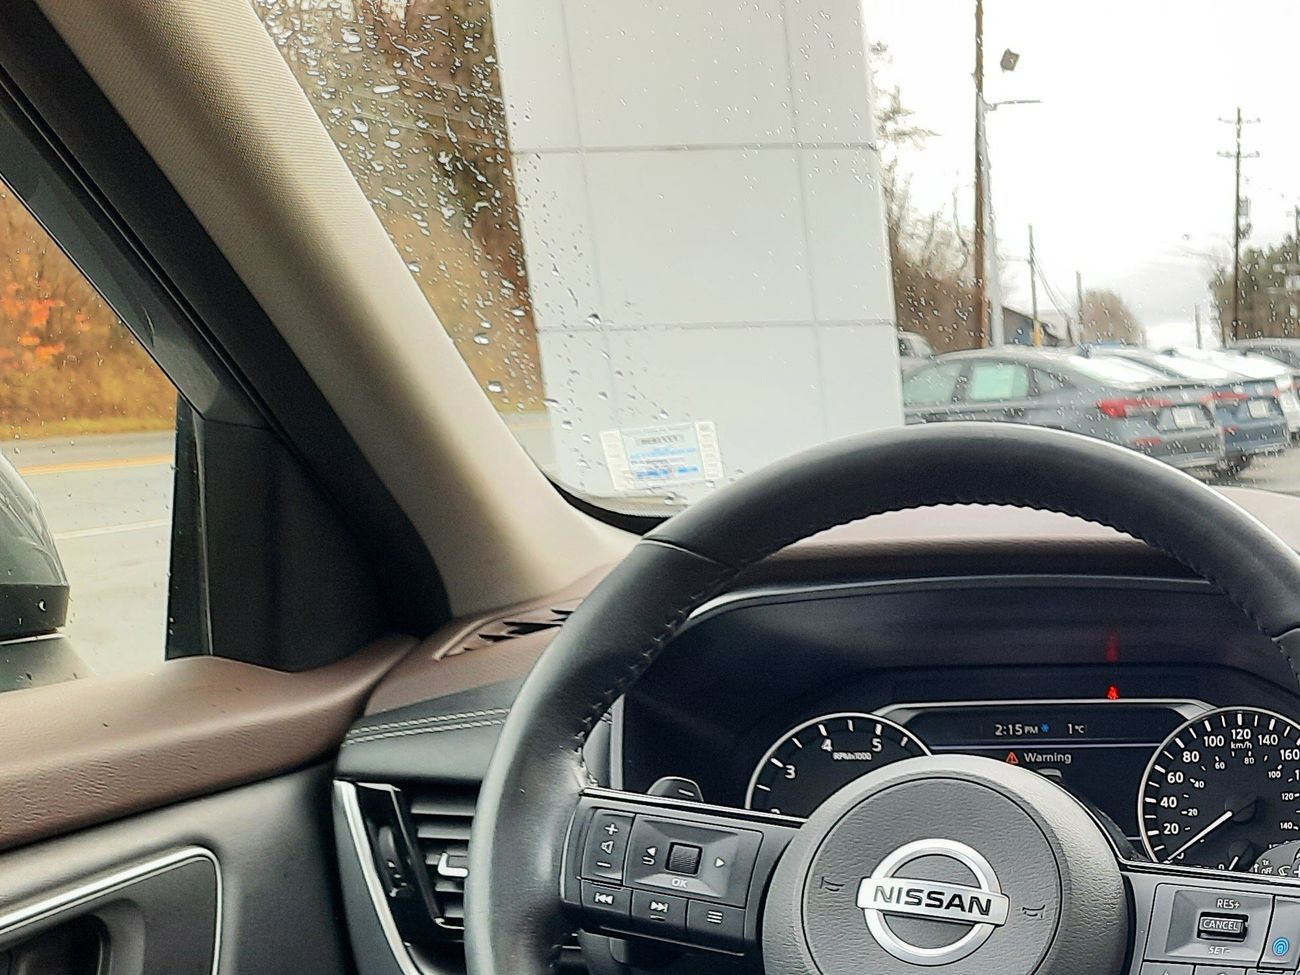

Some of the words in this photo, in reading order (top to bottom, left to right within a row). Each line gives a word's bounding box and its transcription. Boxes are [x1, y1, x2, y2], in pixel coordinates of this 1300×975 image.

[995, 724, 1023, 736] 2:15
[1024, 726, 1039, 735] PM
[1231, 729, 1251, 740] 120
[821, 739, 833, 752] 4
[871, 738, 882, 752] 5
[1203, 735, 1225, 747] 100
[1230, 741, 1252, 750] km/h
[1258, 734, 1278, 746] 140
[1024, 752, 1072, 765] Warning
[1182, 751, 1200, 763] 80
[1280, 749, 1300, 761] 160
[1214, 761, 1225, 770] 60
[784, 765, 796, 780] 3
[1167, 772, 1184, 784] 60
[1268, 771, 1281, 779] 100
[1194, 780, 1205, 789] 40
[1160, 796, 1177, 808] 40
[1281, 792, 1294, 801] 120
[1187, 808, 1198, 817] 20
[1163, 823, 1179, 835] 20
[1280, 821, 1293, 830] 140
[671, 878, 688, 888] OK
[872, 885, 992, 917] NISSAN
[1216, 898, 1240, 909] RES+
[1202, 919, 1238, 930] CANCEL
